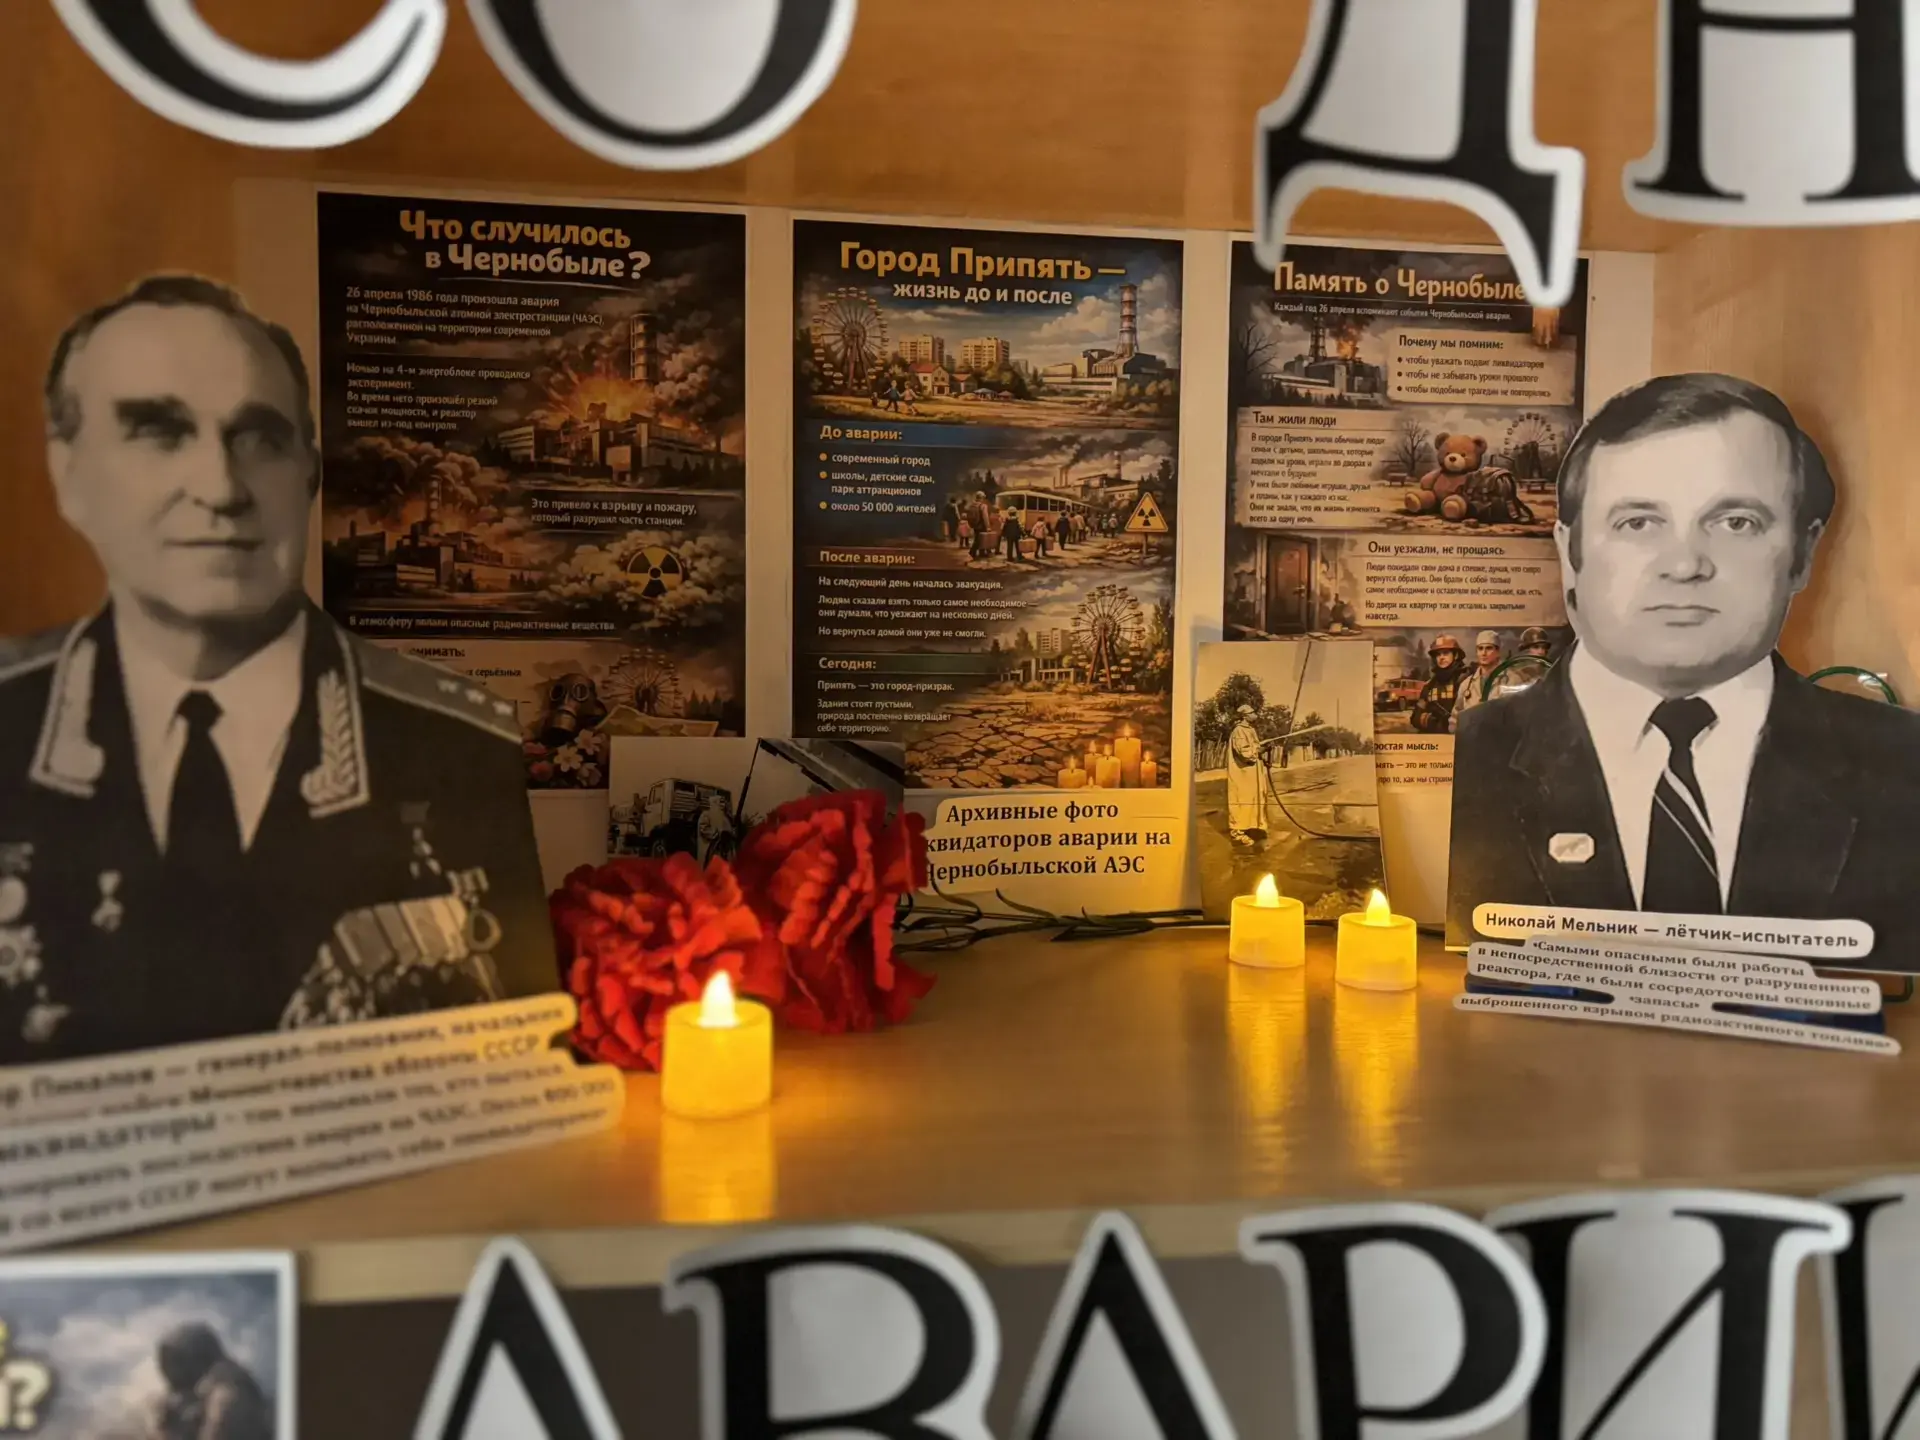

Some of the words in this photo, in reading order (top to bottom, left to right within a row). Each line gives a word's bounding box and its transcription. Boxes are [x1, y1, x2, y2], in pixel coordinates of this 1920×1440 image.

[400, 210, 463, 240] Что
[471, 220, 631, 248] случилось
[426, 252, 442, 268] в
[448, 244, 650, 280] Чернобыле?
[840, 241, 940, 277] Город
[950, 247, 1092, 282] Припять
[1274, 261, 1366, 294] Память
[1376, 278, 1389, 295] о
[1397, 268, 1525, 304] Чернобыле
[346, 286, 360, 298] 26
[364, 290, 403, 301] апреля
[407, 290, 432, 301] 1986
[436, 294, 458, 304] года
[461, 294, 518, 306] произошла
[521, 296, 560, 308] авария
[893, 283, 960, 300] жизнь
[964, 286, 991, 304] до
[996, 288, 1008, 302] и
[1014, 288, 1072, 304] после
[346, 304, 358, 314] на
[361, 304, 448, 318] Чернобыльской
[450, 308, 491, 319] атомной
[494, 311, 570, 323] электростанции
[1400, 335, 1437, 350] Почему
[1440, 338, 1456, 348] мы
[1459, 340, 1504, 350] помним:
[1253, 412, 1274, 424] Там
[1279, 415, 1306, 424] жили
[1308, 415, 1336, 426] люди
[820, 425, 842, 440] До
[846, 428, 902, 442] аварии:
[832, 454, 900, 465] современный
[902, 457, 931, 467] город
[832, 472, 868, 482] школы,
[870, 473, 907, 482] детские
[909, 475, 935, 484] сады,
[832, 485, 854, 496] парк
[857, 486, 922, 496] аттракционов
[532, 498, 550, 510] Это
[552, 500, 590, 513] привело
[593, 502, 599, 510] к
[602, 502, 643, 514] взрыву
[646, 503, 652, 512] и
[654, 503, 698, 516] пожару,
[831, 502, 860, 511] около
[862, 502, 874, 512] 50
[876, 502, 893, 512] 000
[896, 503, 936, 514] жителей
[532, 513, 570, 524] который
[574, 514, 616, 526] разрушил
[619, 516, 643, 525] часть
[645, 516, 684, 527] станции.
[820, 550, 860, 562] После
[864, 554, 916, 566] аварии:
[1368, 541, 1390, 553] Они
[1394, 543, 1439, 556] уезжали,
[1442, 546, 1454, 554] не
[1457, 546, 1504, 558] прощаясь
[819, 576, 831, 586] На
[834, 578, 886, 588] следующий
[889, 580, 910, 588] день
[913, 580, 953, 588] началась
[956, 581, 1003, 590] эвакуация.
[818, 595, 850, 606] Людям
[853, 597, 886, 606] сказали
[888, 598, 910, 606] взять
[913, 598, 941, 607] только
[944, 599, 968, 607] самое
[970, 599, 1026, 608] необходимое
[837, 610, 873, 619] думали,
[891, 611, 927, 620] уезжают
[942, 612, 988, 620] несколько
[990, 611, 1014, 620] дней.
[818, 626, 831, 635] Но
[833, 628, 875, 637] вернуться
[877, 627, 904, 637] домой
[924, 629, 940, 638] уже
[955, 630, 986, 638] смогли.
[819, 657, 876, 671] Сегодня:
[818, 680, 856, 691] Припять
[870, 682, 885, 690] это
[886, 683, 954, 693] город-призрак.
[818, 699, 848, 709] Здания
[875, 700, 914, 710] пустыми,
[946, 805, 1058, 826] Архивные
[1064, 800, 1118, 822] фото
[926, 832, 1051, 852] квидаторов
[1058, 832, 1138, 850] аварии
[1145, 832, 1170, 845] на
[1104, 856, 1145, 874] АЭС
[1486, 912, 1556, 930] Николай
[1562, 916, 1638, 935] Мельник
[1665, 923, 1859, 948] лётчик-испытатель
[1604, 948, 1686, 966] опасными
[1691, 956, 1737, 970] были
[1742, 960, 1804, 977] работы
[1490, 949, 1634, 974] непосредственной
[1638, 961, 1716, 982] близости
[1721, 973, 1740, 982] от
[1744, 976, 1870, 994] разрушенного
[1478, 962, 1550, 981] реактора,
[1555, 970, 1580, 984] где
[1586, 976, 1596, 984] и
[1600, 975, 1644, 991] были
[1649, 982, 1780, 1004] сосредоточены
[1784, 995, 1870, 1010] основные
[1461, 997, 1578, 1014] выброшенного
[1583, 1005, 1656, 1020] взрывом
[1660, 1012, 1804, 1037] радиоактивного
[425, 1192, 1920, 1440] АВАРИ
